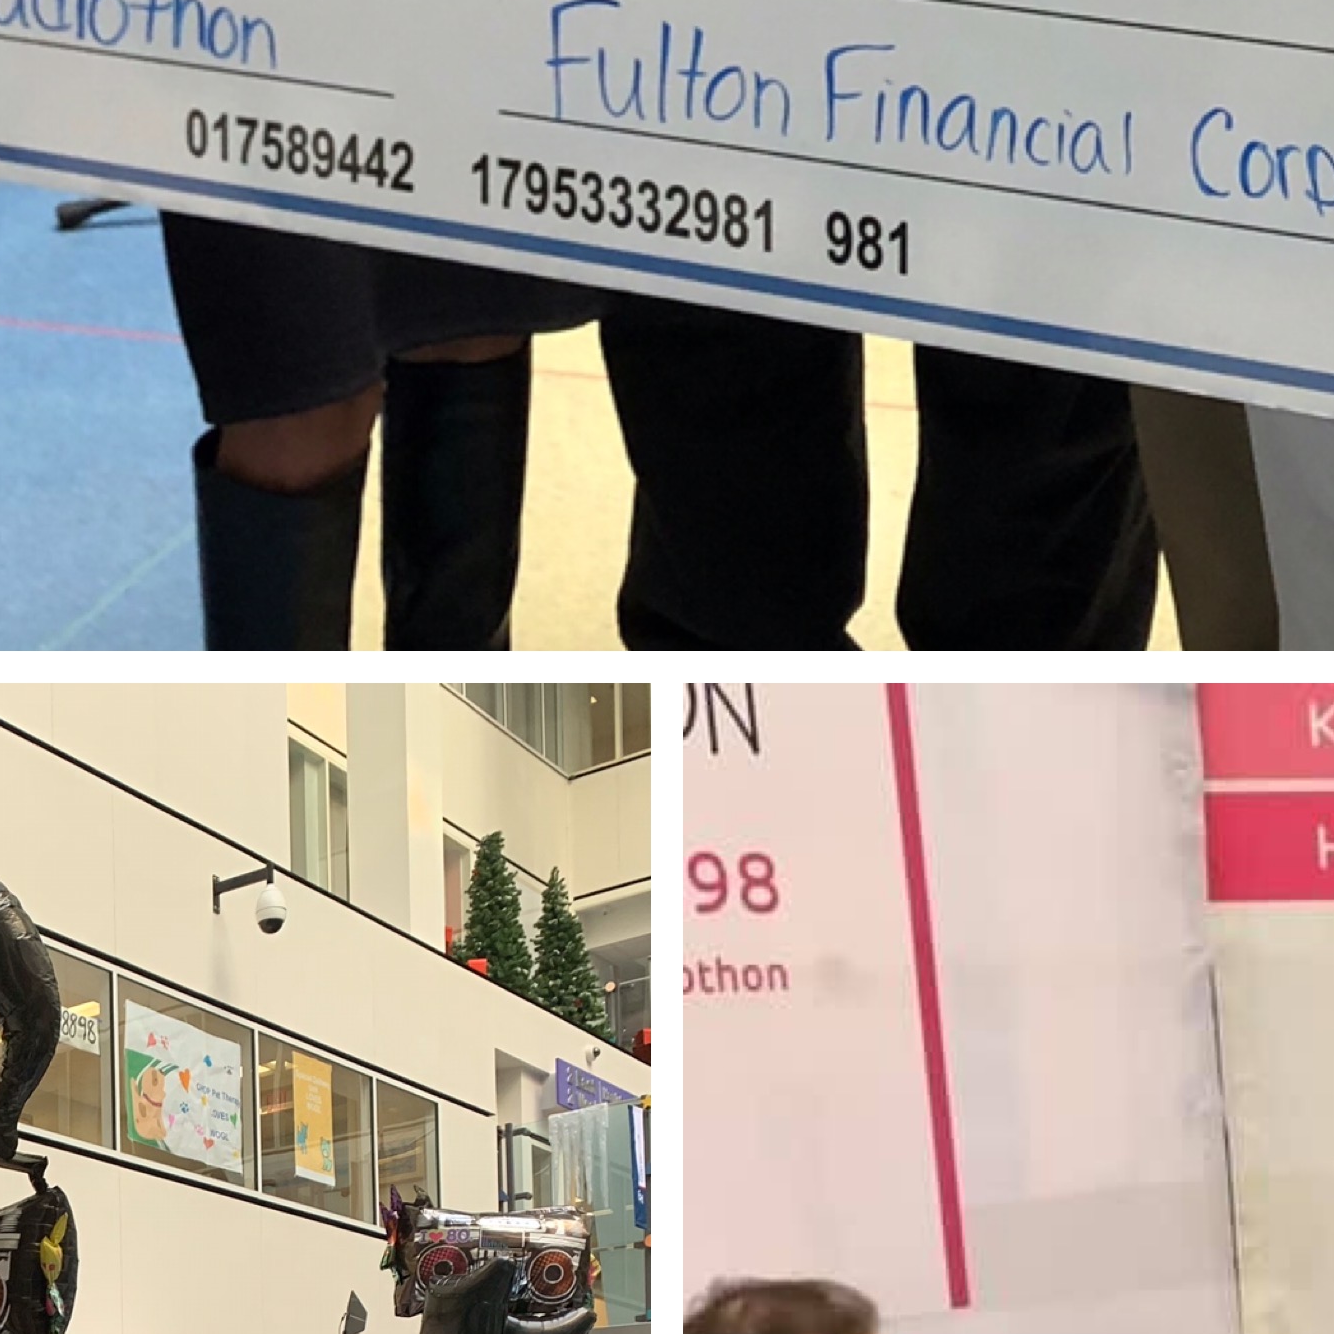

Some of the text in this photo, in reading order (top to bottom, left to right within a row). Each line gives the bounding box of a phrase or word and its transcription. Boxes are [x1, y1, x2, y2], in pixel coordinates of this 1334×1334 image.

[822, 43, 1134, 175] Financial
[185, 109, 911, 275] 017589442 17953332981 981
